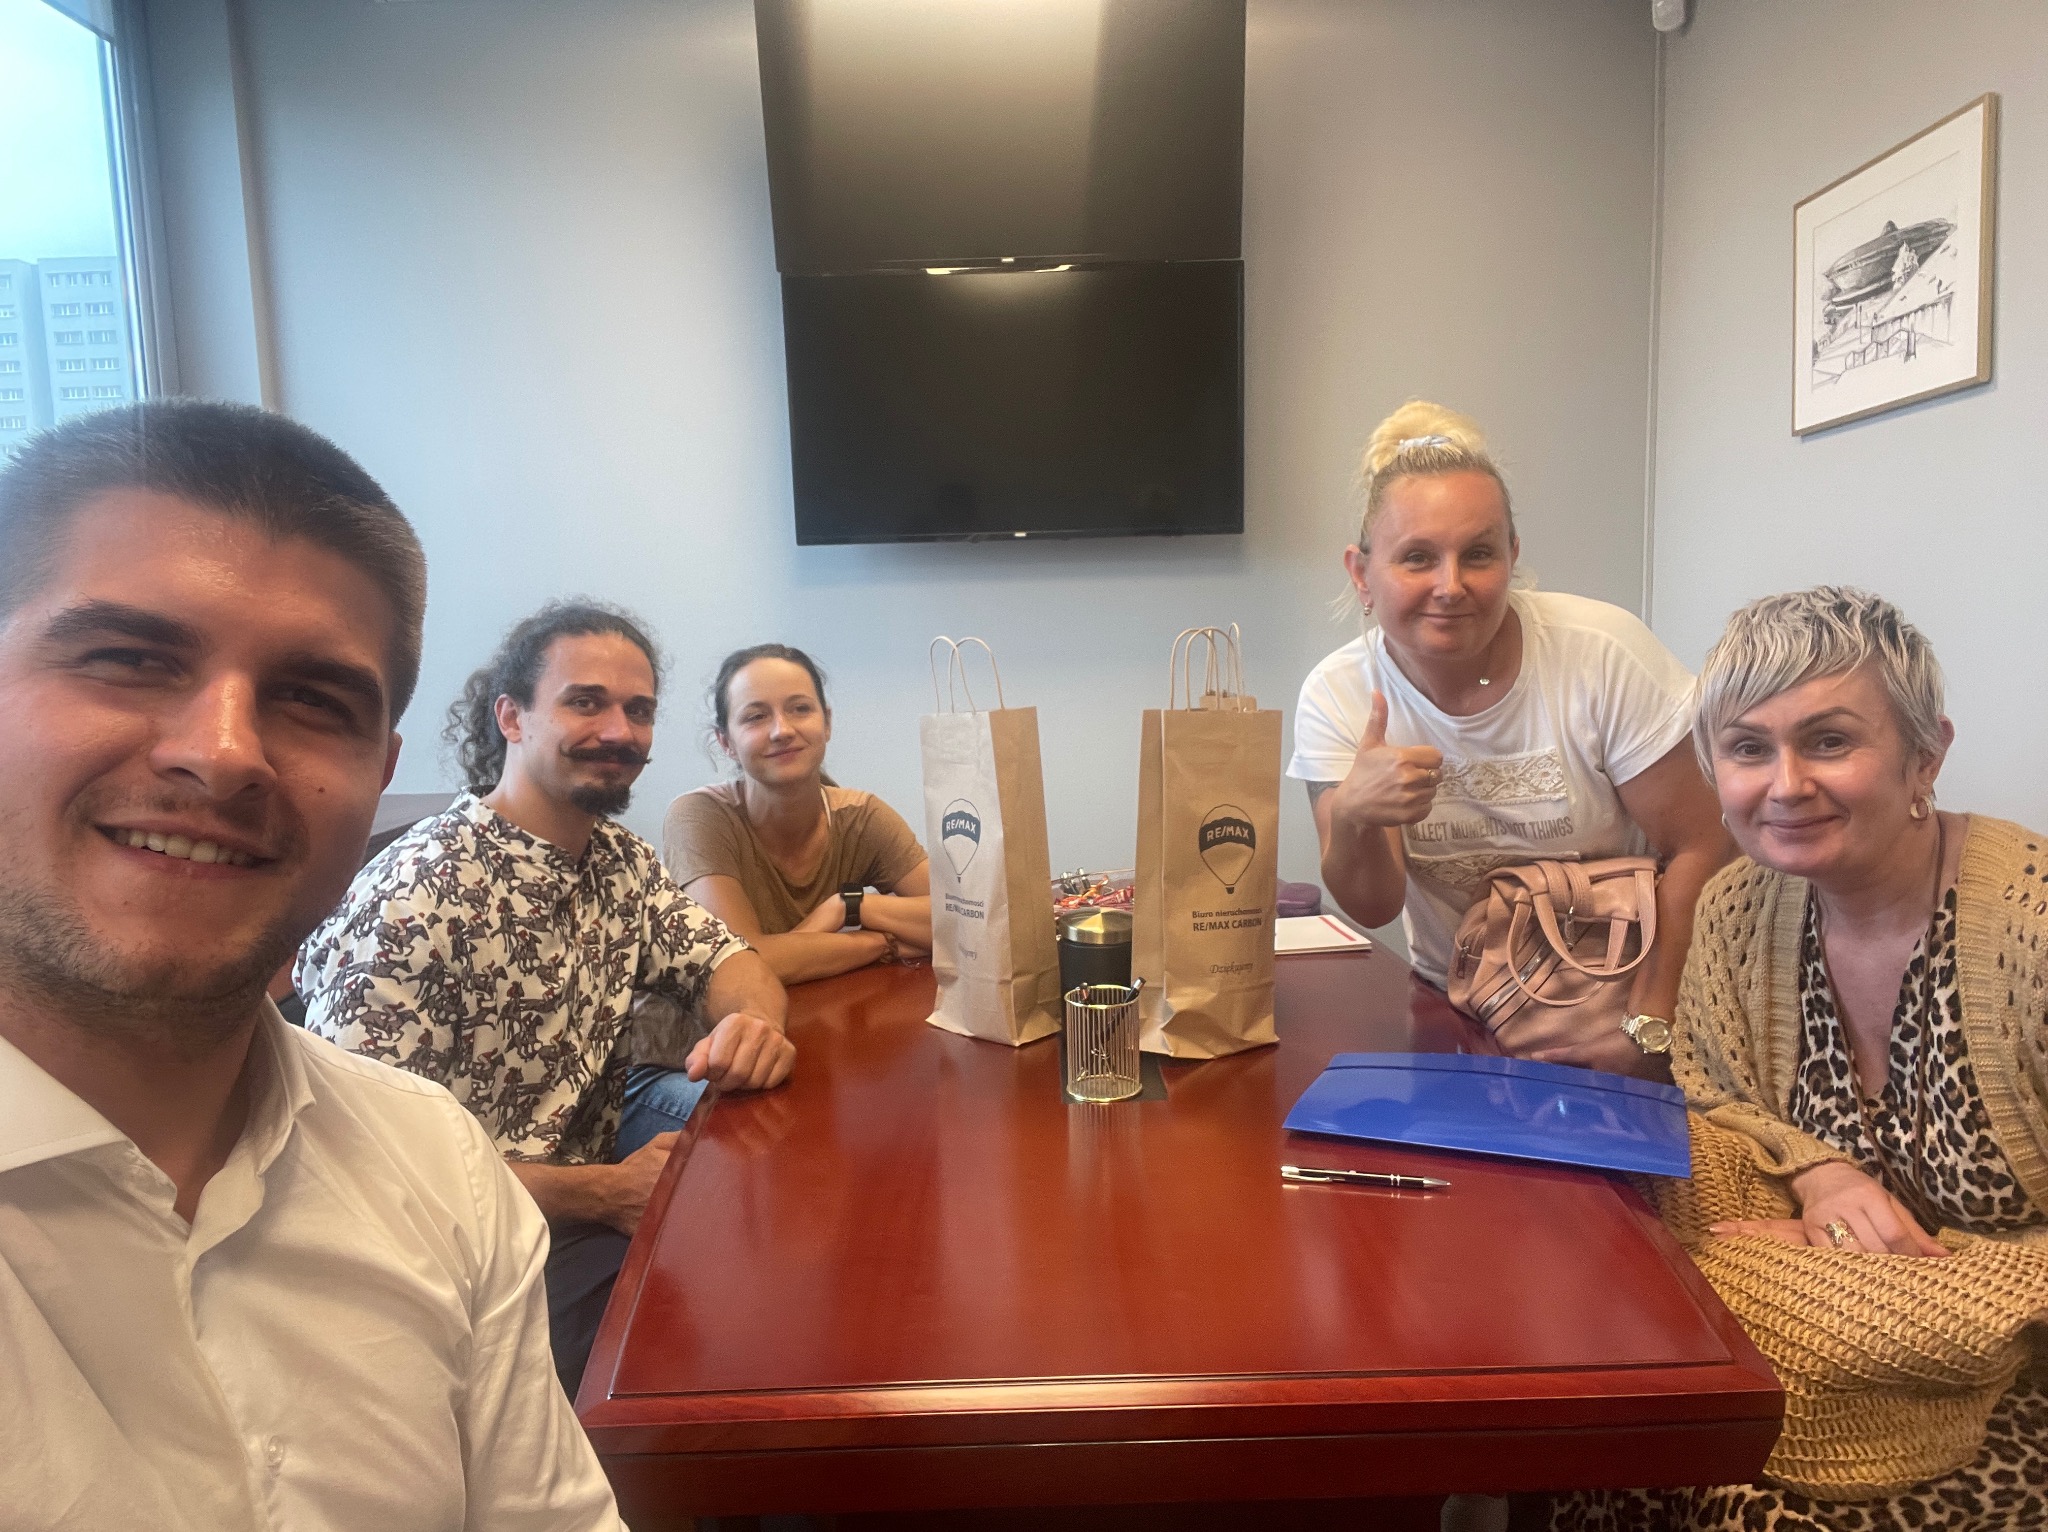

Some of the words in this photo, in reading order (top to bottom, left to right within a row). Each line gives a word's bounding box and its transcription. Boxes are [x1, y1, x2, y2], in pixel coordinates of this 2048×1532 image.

[946, 819, 976, 834] RE/MAX
[1206, 825, 1249, 842] RE/MAX
[1529, 816, 1573, 840] THINGS
[1192, 910, 1214, 918] Biuro
[1193, 921, 1230, 931] RE/MAX
[1231, 918, 1262, 929] CARBON
